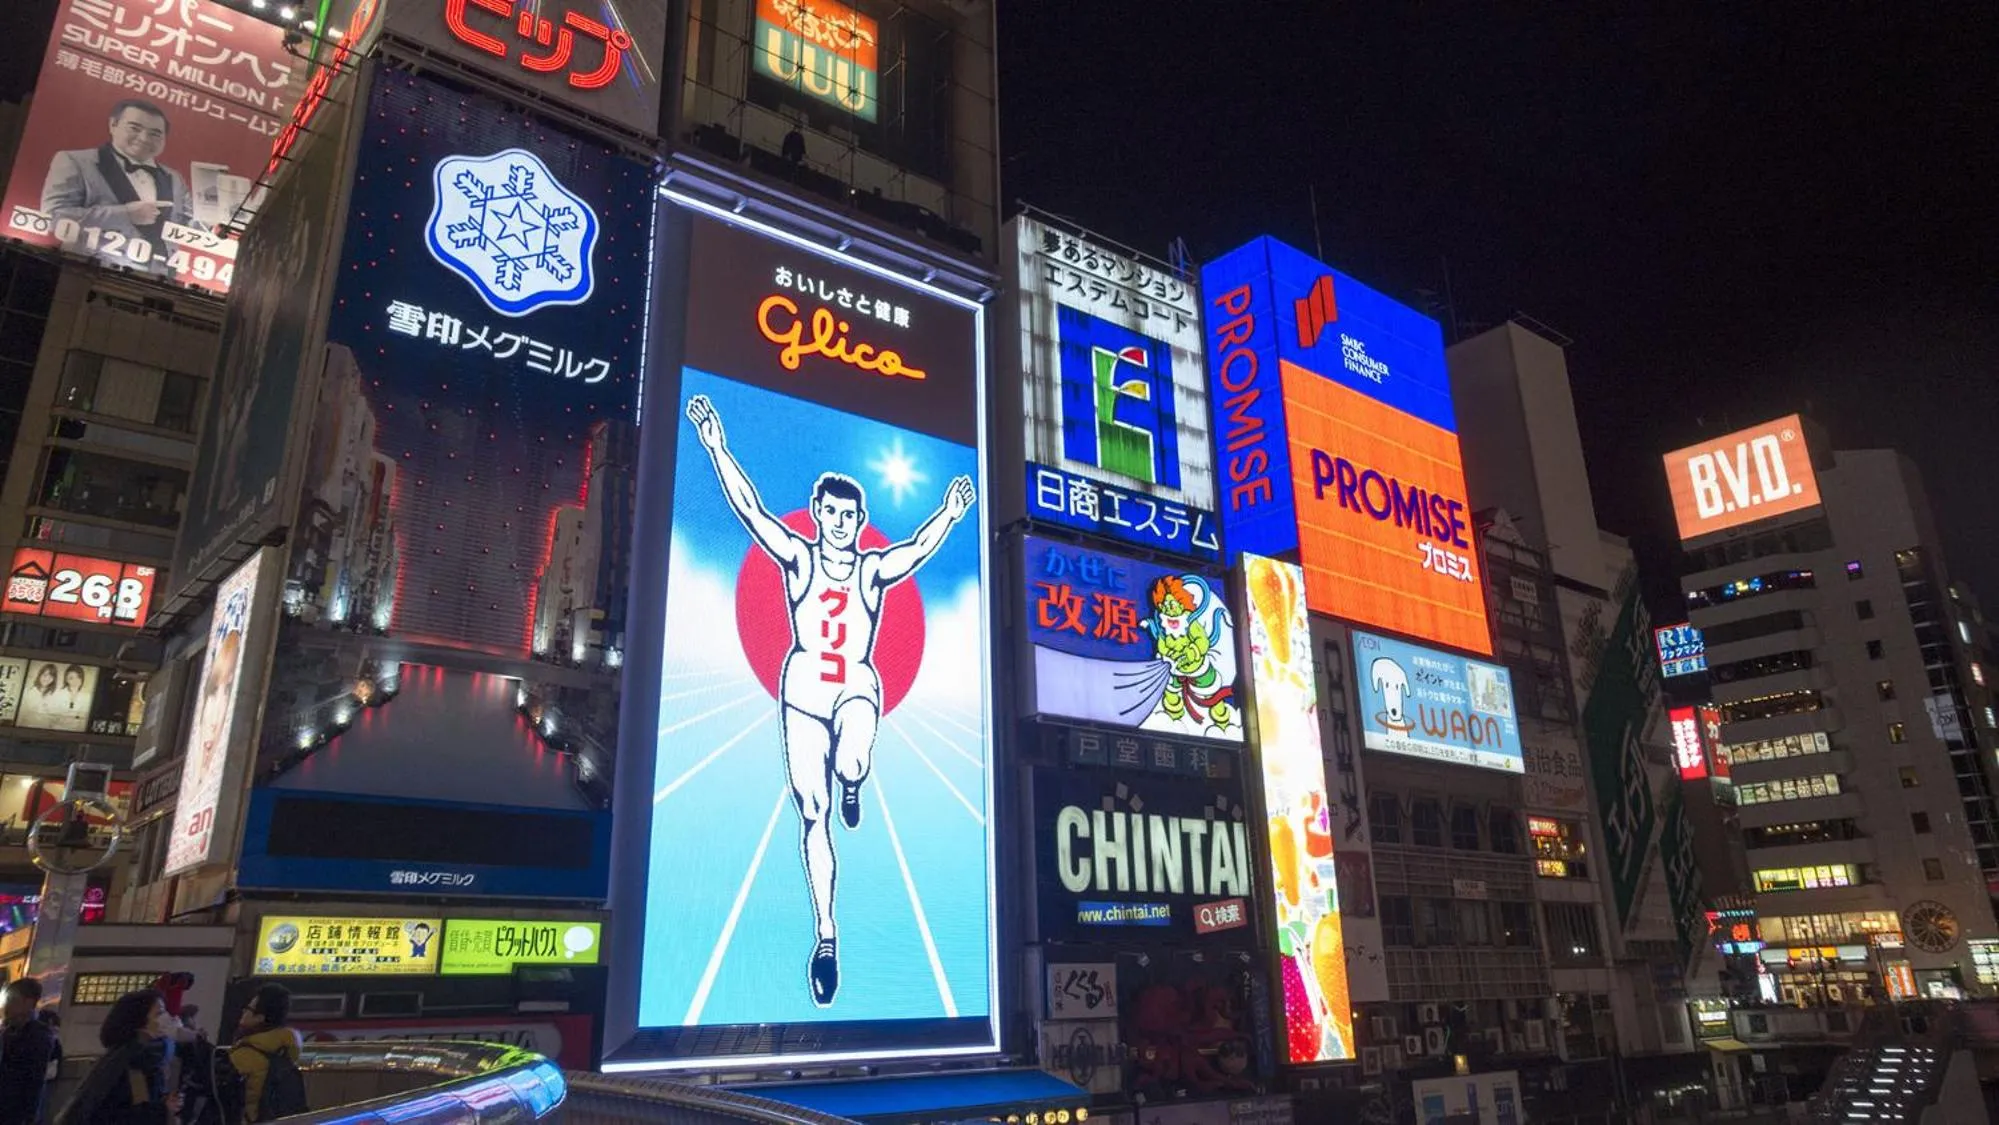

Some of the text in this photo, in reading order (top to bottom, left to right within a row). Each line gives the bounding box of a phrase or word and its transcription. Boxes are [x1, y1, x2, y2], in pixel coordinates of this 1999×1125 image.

[62, 23, 159, 69] SUPER
[167, 59, 266, 105] MILLION
[774, 266, 912, 328] おいしさと健康
[1044, 262, 1188, 334] エステムコート
[386, 300, 610, 383] 雪印メグミルク
[1344, 357, 1382, 385] FINANCE
[1215, 284, 1274, 511] PROMISE
[1036, 467, 1219, 551] 日商エステム
[1310, 447, 1469, 550] PROMISE
[1417, 542, 1475, 585] プロミス
[818, 586, 851, 684] グリコ
[1036, 581, 1140, 645] 改源
[390, 870, 475, 887] 雪印メグミルク
[1057, 805, 1250, 897] CHINTAI
[306, 925, 401, 941] 店舗情報館
[494, 924, 558, 957] ピタットハウス
[1214, 903, 1241, 923] 検索
